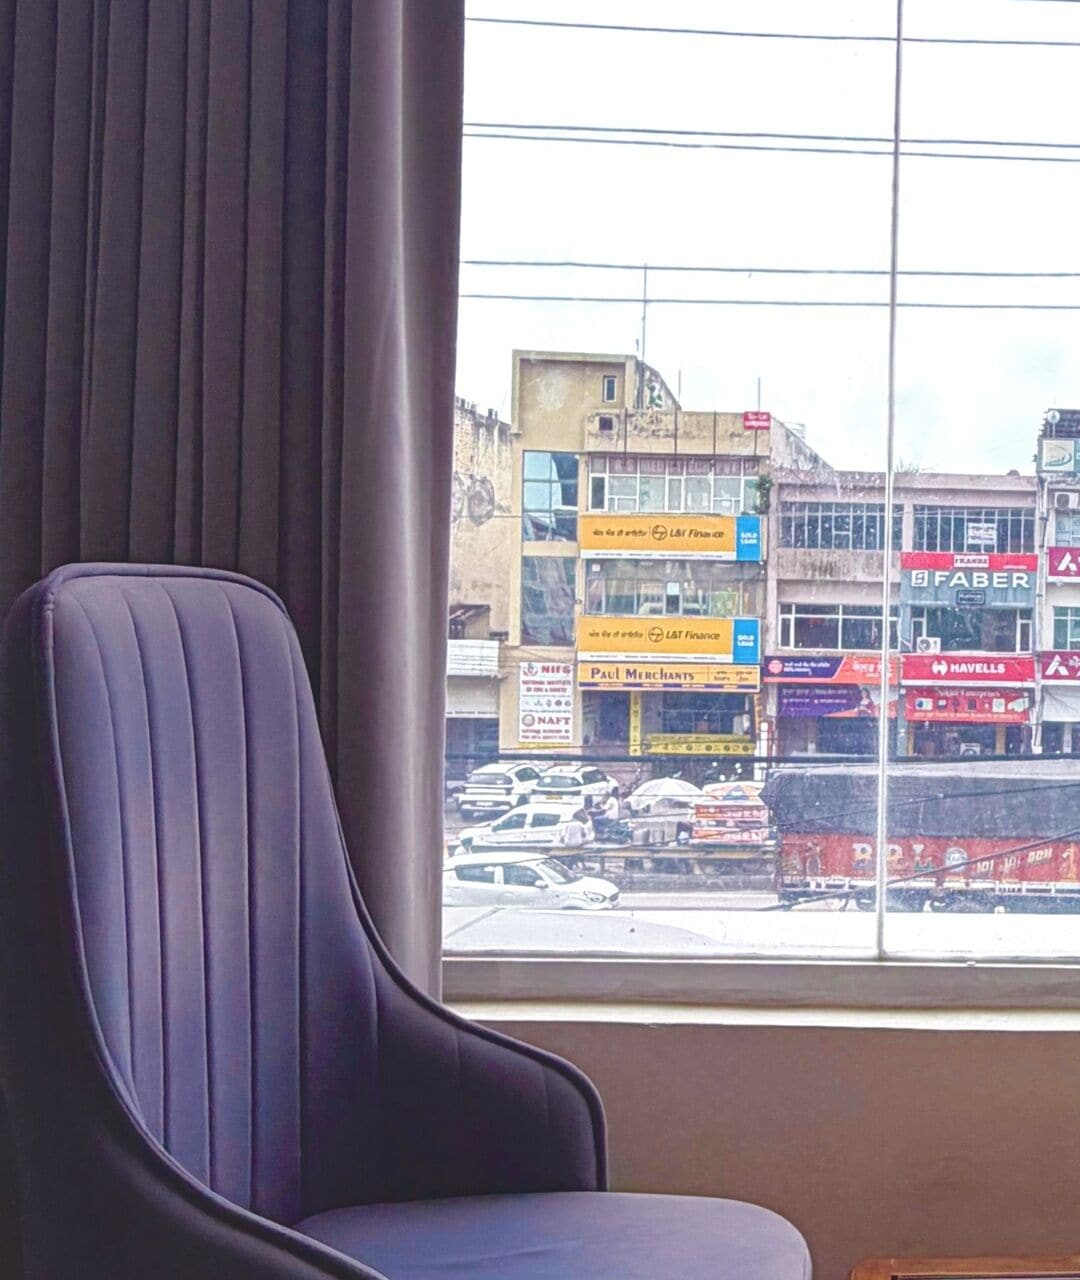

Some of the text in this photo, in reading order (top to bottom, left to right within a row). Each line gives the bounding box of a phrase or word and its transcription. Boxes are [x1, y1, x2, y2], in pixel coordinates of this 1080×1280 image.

[688, 528, 724, 539] Finance
[934, 571, 1030, 588] FABER
[666, 630, 721, 641] L&T Finance
[541, 665, 571, 674] NIFS
[950, 663, 1006, 673] HAVELLS
[537, 716, 571, 725] NAFT
